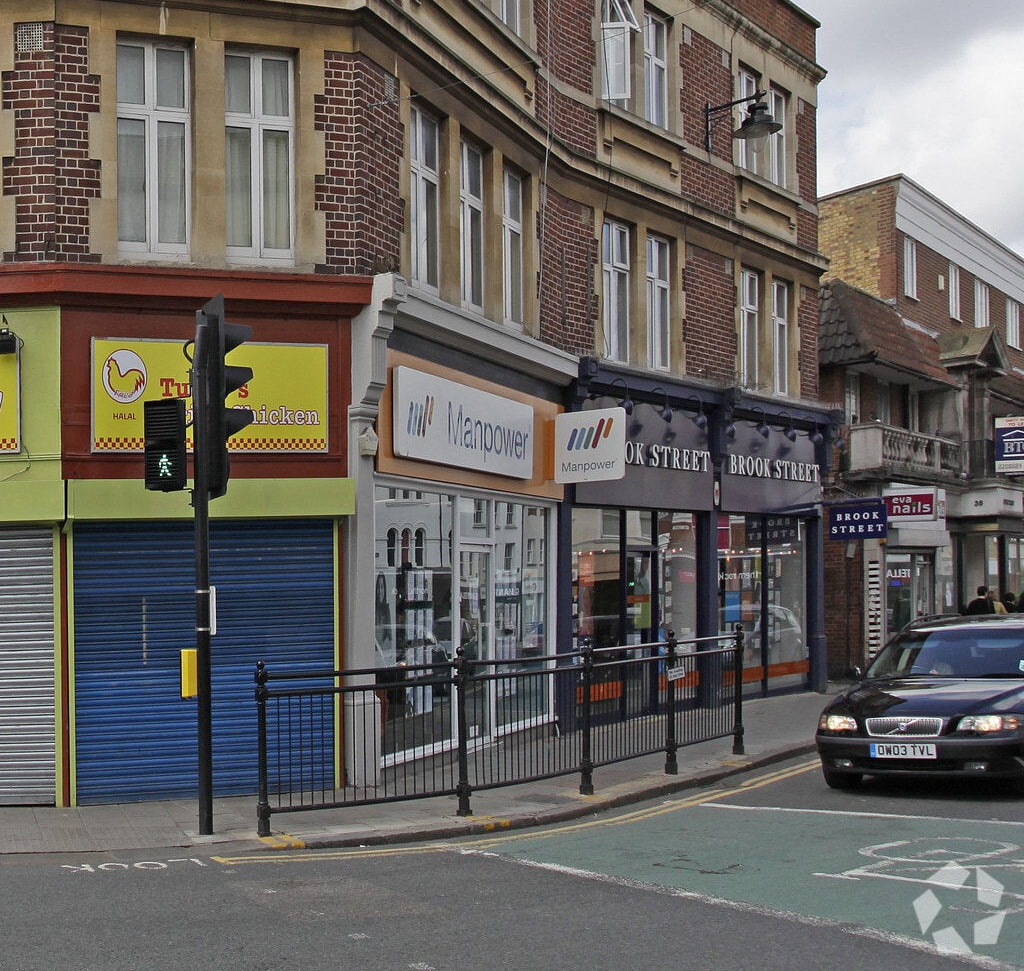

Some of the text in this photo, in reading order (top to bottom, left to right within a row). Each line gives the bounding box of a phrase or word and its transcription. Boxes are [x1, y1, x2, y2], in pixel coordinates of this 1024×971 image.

[112, 412, 137, 421] HALAL
[232, 404, 321, 426] icken
[447, 400, 530, 463] Manpower
[652, 444, 711, 472] STREET
[561, 460, 617, 473] Manpower
[729, 453, 820, 483] BROOK STREET
[892, 496, 913, 504] eva
[892, 501, 931, 514] nails
[836, 511, 880, 522] BROOK
[831, 523, 884, 534] STREET
[910, 744, 934, 756] TVL
